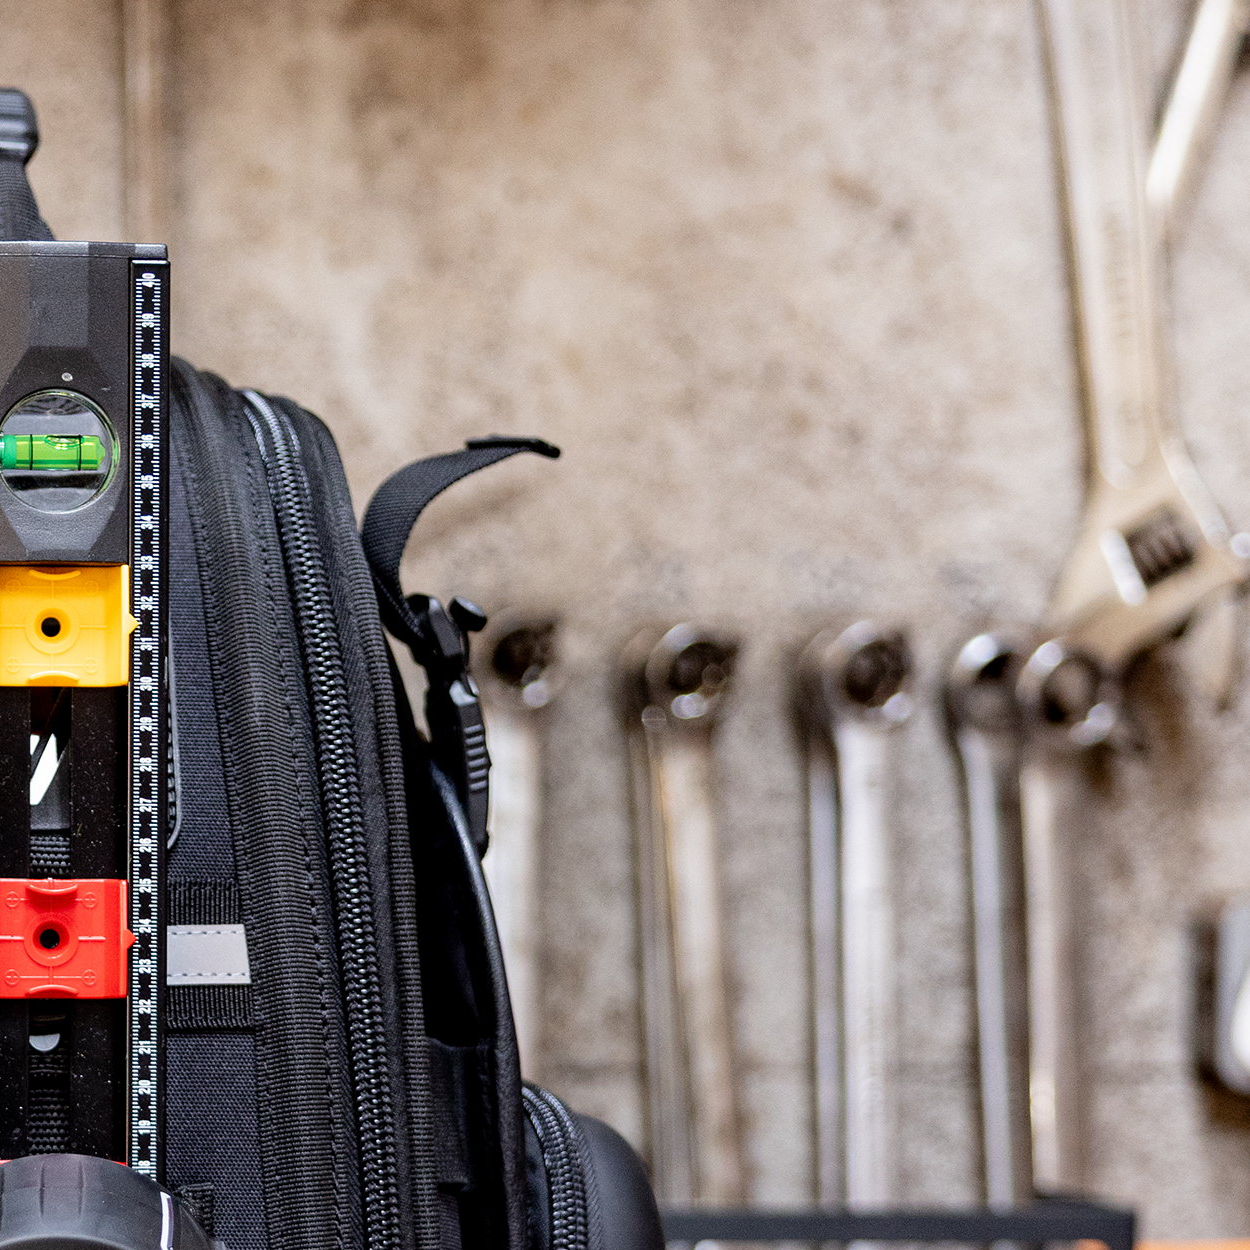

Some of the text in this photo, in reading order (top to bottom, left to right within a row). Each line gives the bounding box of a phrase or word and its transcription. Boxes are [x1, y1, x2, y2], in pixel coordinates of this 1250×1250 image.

[141, 272, 154, 287] 40
[141, 313, 154, 328] 39
[141, 353, 154, 368] 38
[141, 393, 154, 409] 37
[141, 434, 154, 449] 36
[141, 474, 154, 490] 35
[141, 515, 154, 530] 34
[140, 555, 153, 570] 33
[140, 596, 153, 611] 32
[140, 637, 153, 651] 31
[140, 676, 153, 691] 30
[140, 716, 153, 732] 29
[140, 757, 153, 772] 28
[140, 798, 153, 812] 27
[140, 838, 152, 853] 26
[139, 878, 152, 893] 25
[139, 918, 152, 934] 24
[139, 958, 152, 974] 23
[139, 999, 152, 1014] 22
[139, 1040, 152, 1055] 21
[139, 1079, 152, 1095] 20
[139, 1119, 152, 1135] 19
